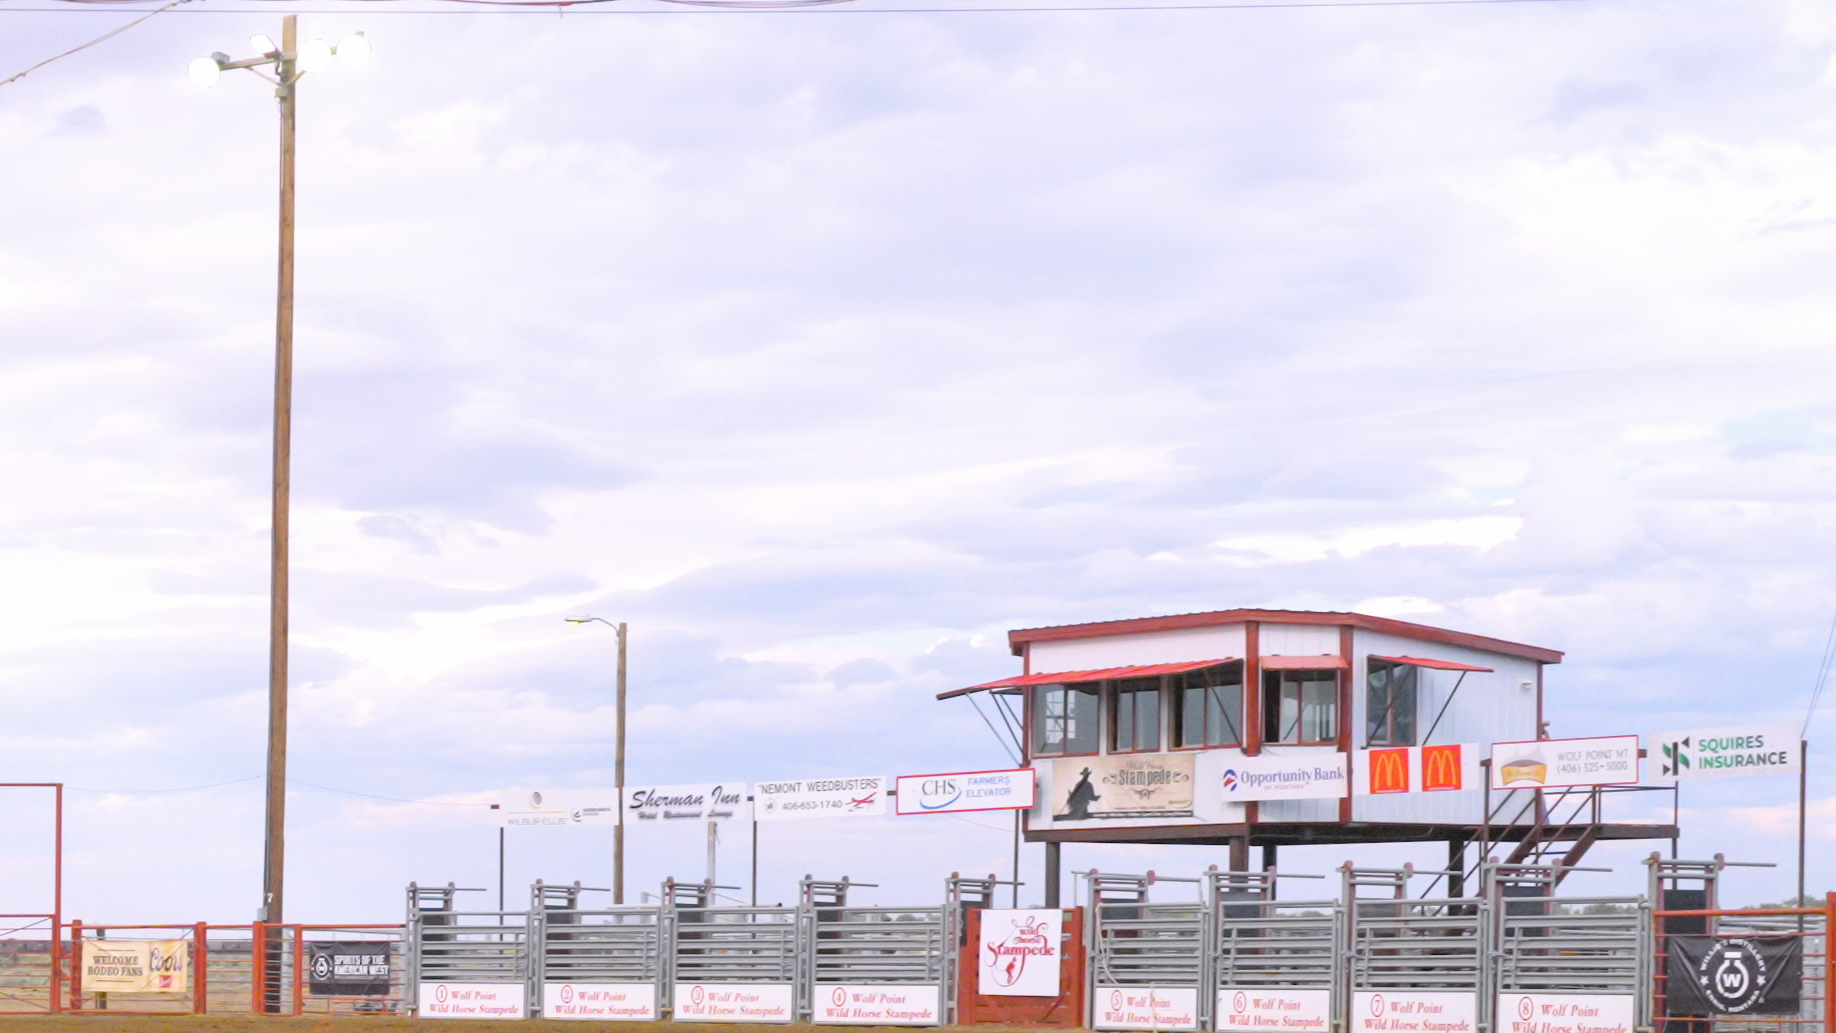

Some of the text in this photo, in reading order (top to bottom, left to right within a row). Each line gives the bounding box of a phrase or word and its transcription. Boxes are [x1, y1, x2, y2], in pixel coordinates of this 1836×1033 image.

[1698, 735, 1765, 753] SQUIRES
[1557, 749, 1628, 761] WOLF POINT MT
[1699, 751, 1788, 769] INSURANCE
[1556, 763, 1581, 773] (406)
[967, 776, 1011, 785] FARMERS
[1118, 769, 1171, 786] Stampede
[1240, 766, 1345, 787] Opportunity Bank
[922, 778, 957, 796] CHS
[966, 787, 1012, 798] ELEVATOR
[629, 785, 741, 809] Sherman Inn
[93, 955, 139, 965] WELCOME
[334, 955, 360, 965] SPIRITS
[87, 966, 143, 976] RODEO FANS
[1722, 973, 1741, 987] W
[451, 990, 472, 1000] Wolf
[474, 991, 497, 1000] Point
[578, 992, 601, 1001] Wolf
[603, 992, 626, 1001] Point
[708, 992, 732, 1002] Wolf
[734, 993, 759, 1002] Point
[852, 993, 877, 1003] Wolf
[880, 994, 906, 1004] Point
[1127, 996, 1148, 1007] Wolf
[1252, 998, 1276, 1010] Wolf
[1277, 999, 1301, 1010] Point
[1390, 1001, 1415, 1013] Wolf
[1417, 1002, 1443, 1013] Point
[429, 1004, 519, 1016] Wild Horse Stampede
[555, 1005, 650, 1017] Wild Horse Stampede
[683, 1005, 784, 1017] Wild Horse Stampede
[826, 1008, 932, 1021] Wild Horse Stampede
[1541, 1004, 1568, 1016] Wolf
[1570, 1004, 1599, 1017] Point
[1105, 1011, 1191, 1027] Wild Horse Stampede
[1229, 1014, 1324, 1030] Wild Horse Stampede
[1364, 1018, 1469, 1033] Wild Horse Stampede
[1512, 1021, 1537, 1033] Wild
[1541, 1022, 1572, 1033] Horse
